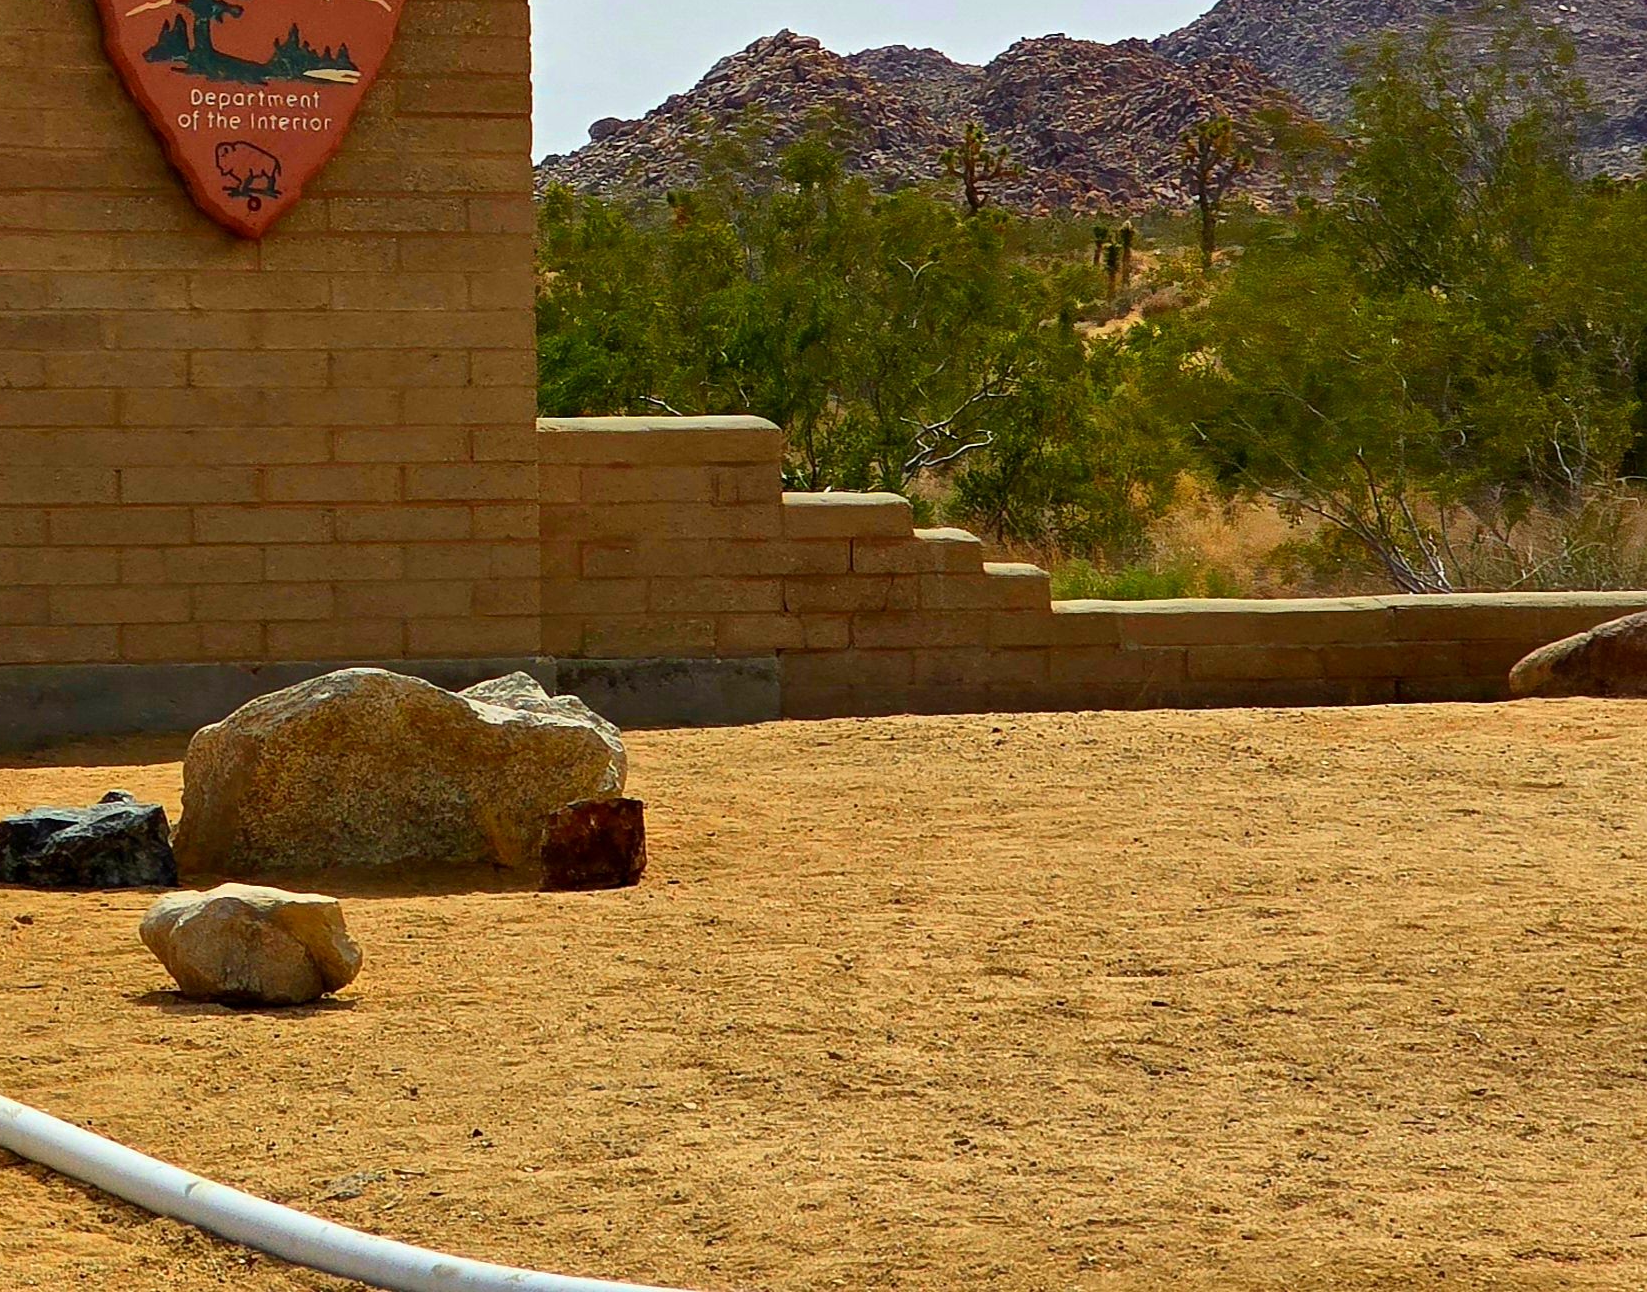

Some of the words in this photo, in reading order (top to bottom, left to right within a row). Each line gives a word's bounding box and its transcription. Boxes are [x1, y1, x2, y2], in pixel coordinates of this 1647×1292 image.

[190, 88, 320, 110] Department
[177, 110, 200, 131] of
[207, 111, 241, 130] the
[249, 111, 334, 132] Interior
